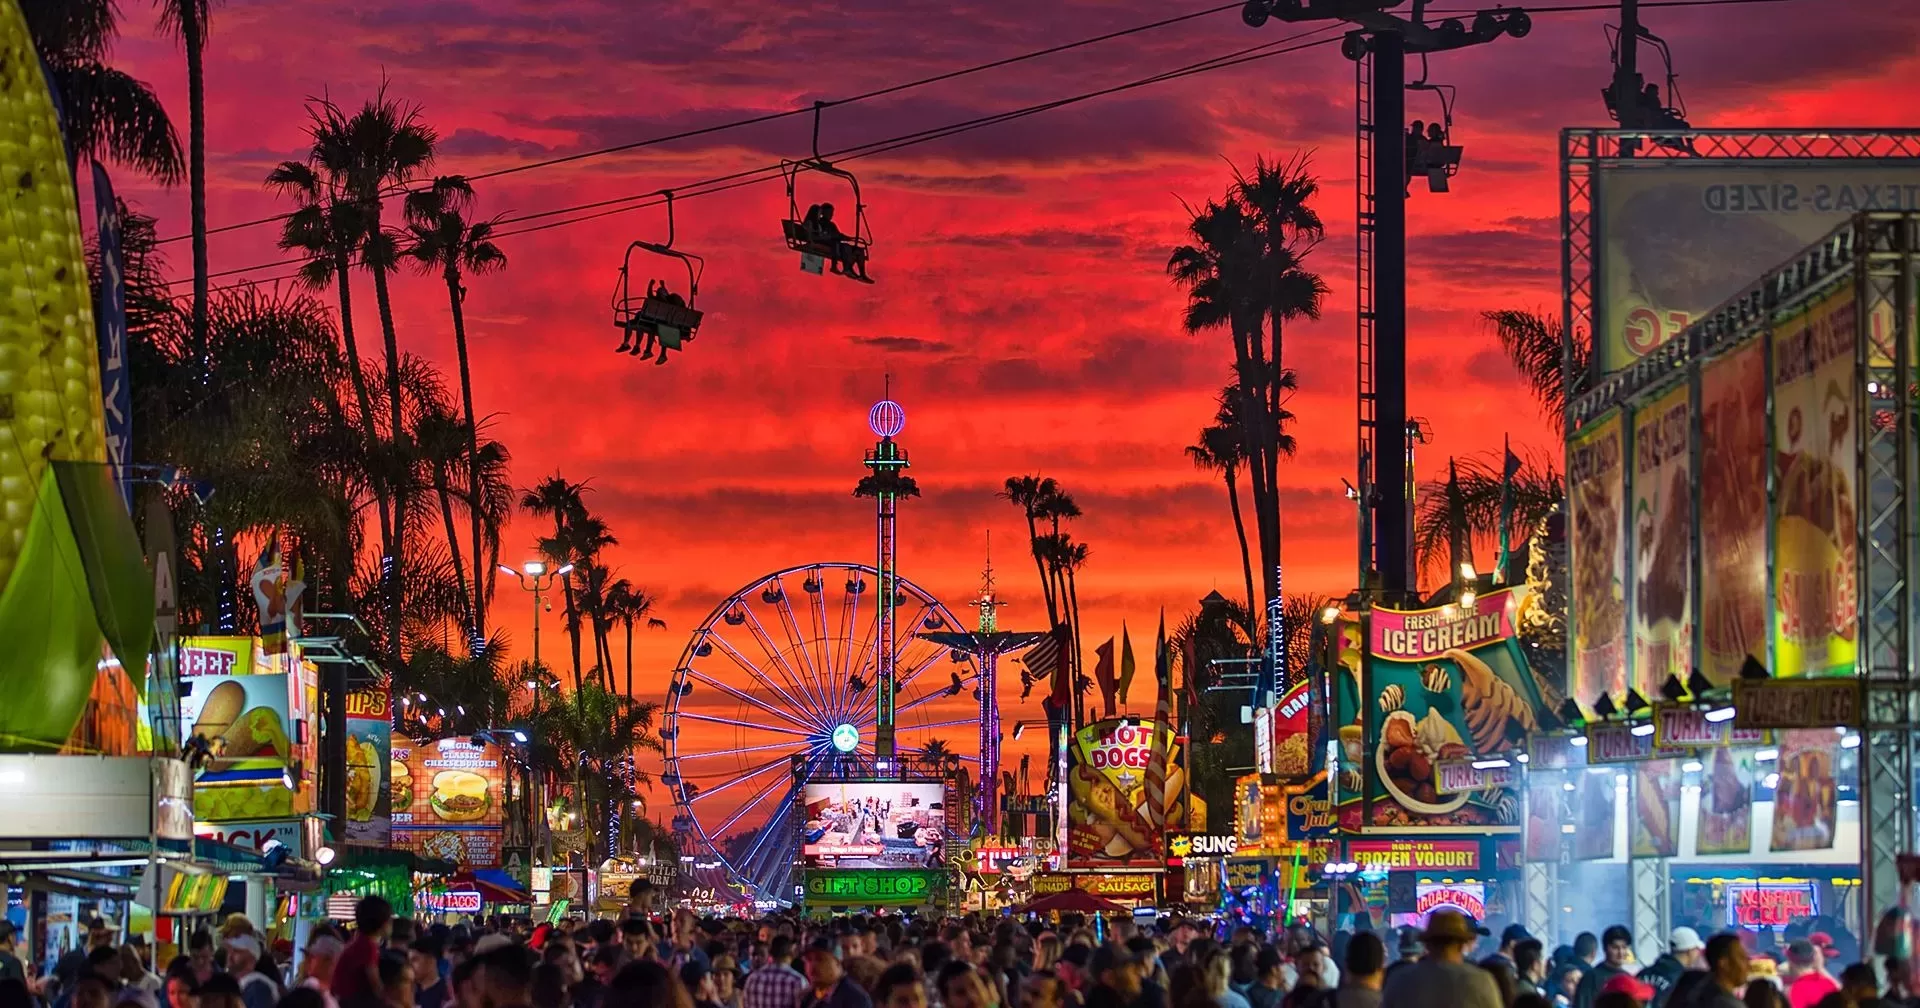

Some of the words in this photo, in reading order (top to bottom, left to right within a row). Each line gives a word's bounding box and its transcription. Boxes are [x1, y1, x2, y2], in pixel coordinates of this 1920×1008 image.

[1404, 602, 1479, 630] FRESH-MADE
[1383, 627, 1419, 655] ICE
[1422, 611, 1500, 654] CREAM
[346, 690, 387, 716] IPS
[1819, 685, 1853, 722] LEG
[1099, 725, 1154, 746] HOT
[437, 739, 485, 753] OIGINAL
[391, 750, 409, 760] RS
[442, 752, 480, 760] CLASSIC
[1091, 747, 1152, 770] DOGS
[424, 760, 498, 769] CHEESEBURGER
[1193, 836, 1237, 853] SUNG
[1354, 851, 1411, 868] FROZEN
[1415, 851, 1474, 867] YOGURT
[648, 865, 677, 877] TTLE
[810, 878, 859, 894] GIFT
[864, 878, 926, 894] SHOP
[1098, 882, 1155, 893] SAUSAG
[447, 895, 479, 908] TACOS
